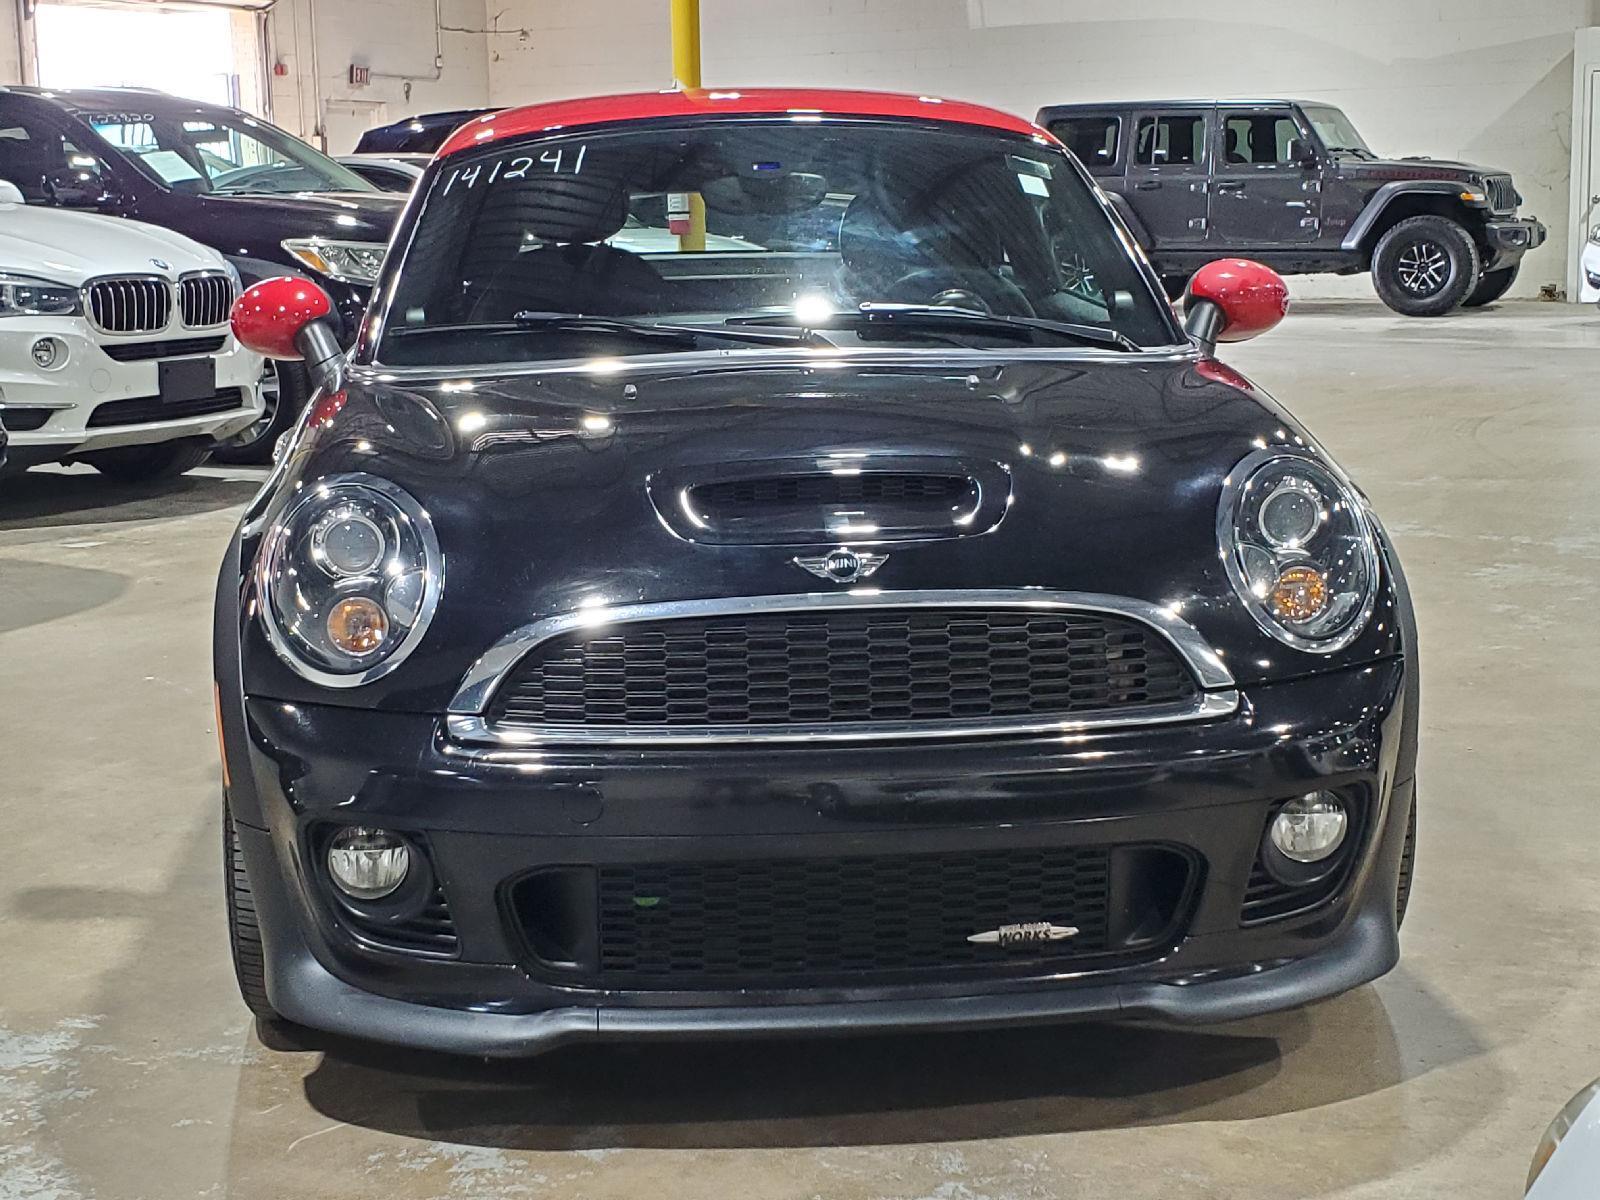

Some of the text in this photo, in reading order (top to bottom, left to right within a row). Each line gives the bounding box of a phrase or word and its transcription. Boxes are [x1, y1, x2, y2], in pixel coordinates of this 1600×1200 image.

[355, 67, 369, 85] EXIT
[443, 145, 586, 196] 141241
[828, 558, 857, 569] MINI
[999, 928, 1051, 942] WORKS
